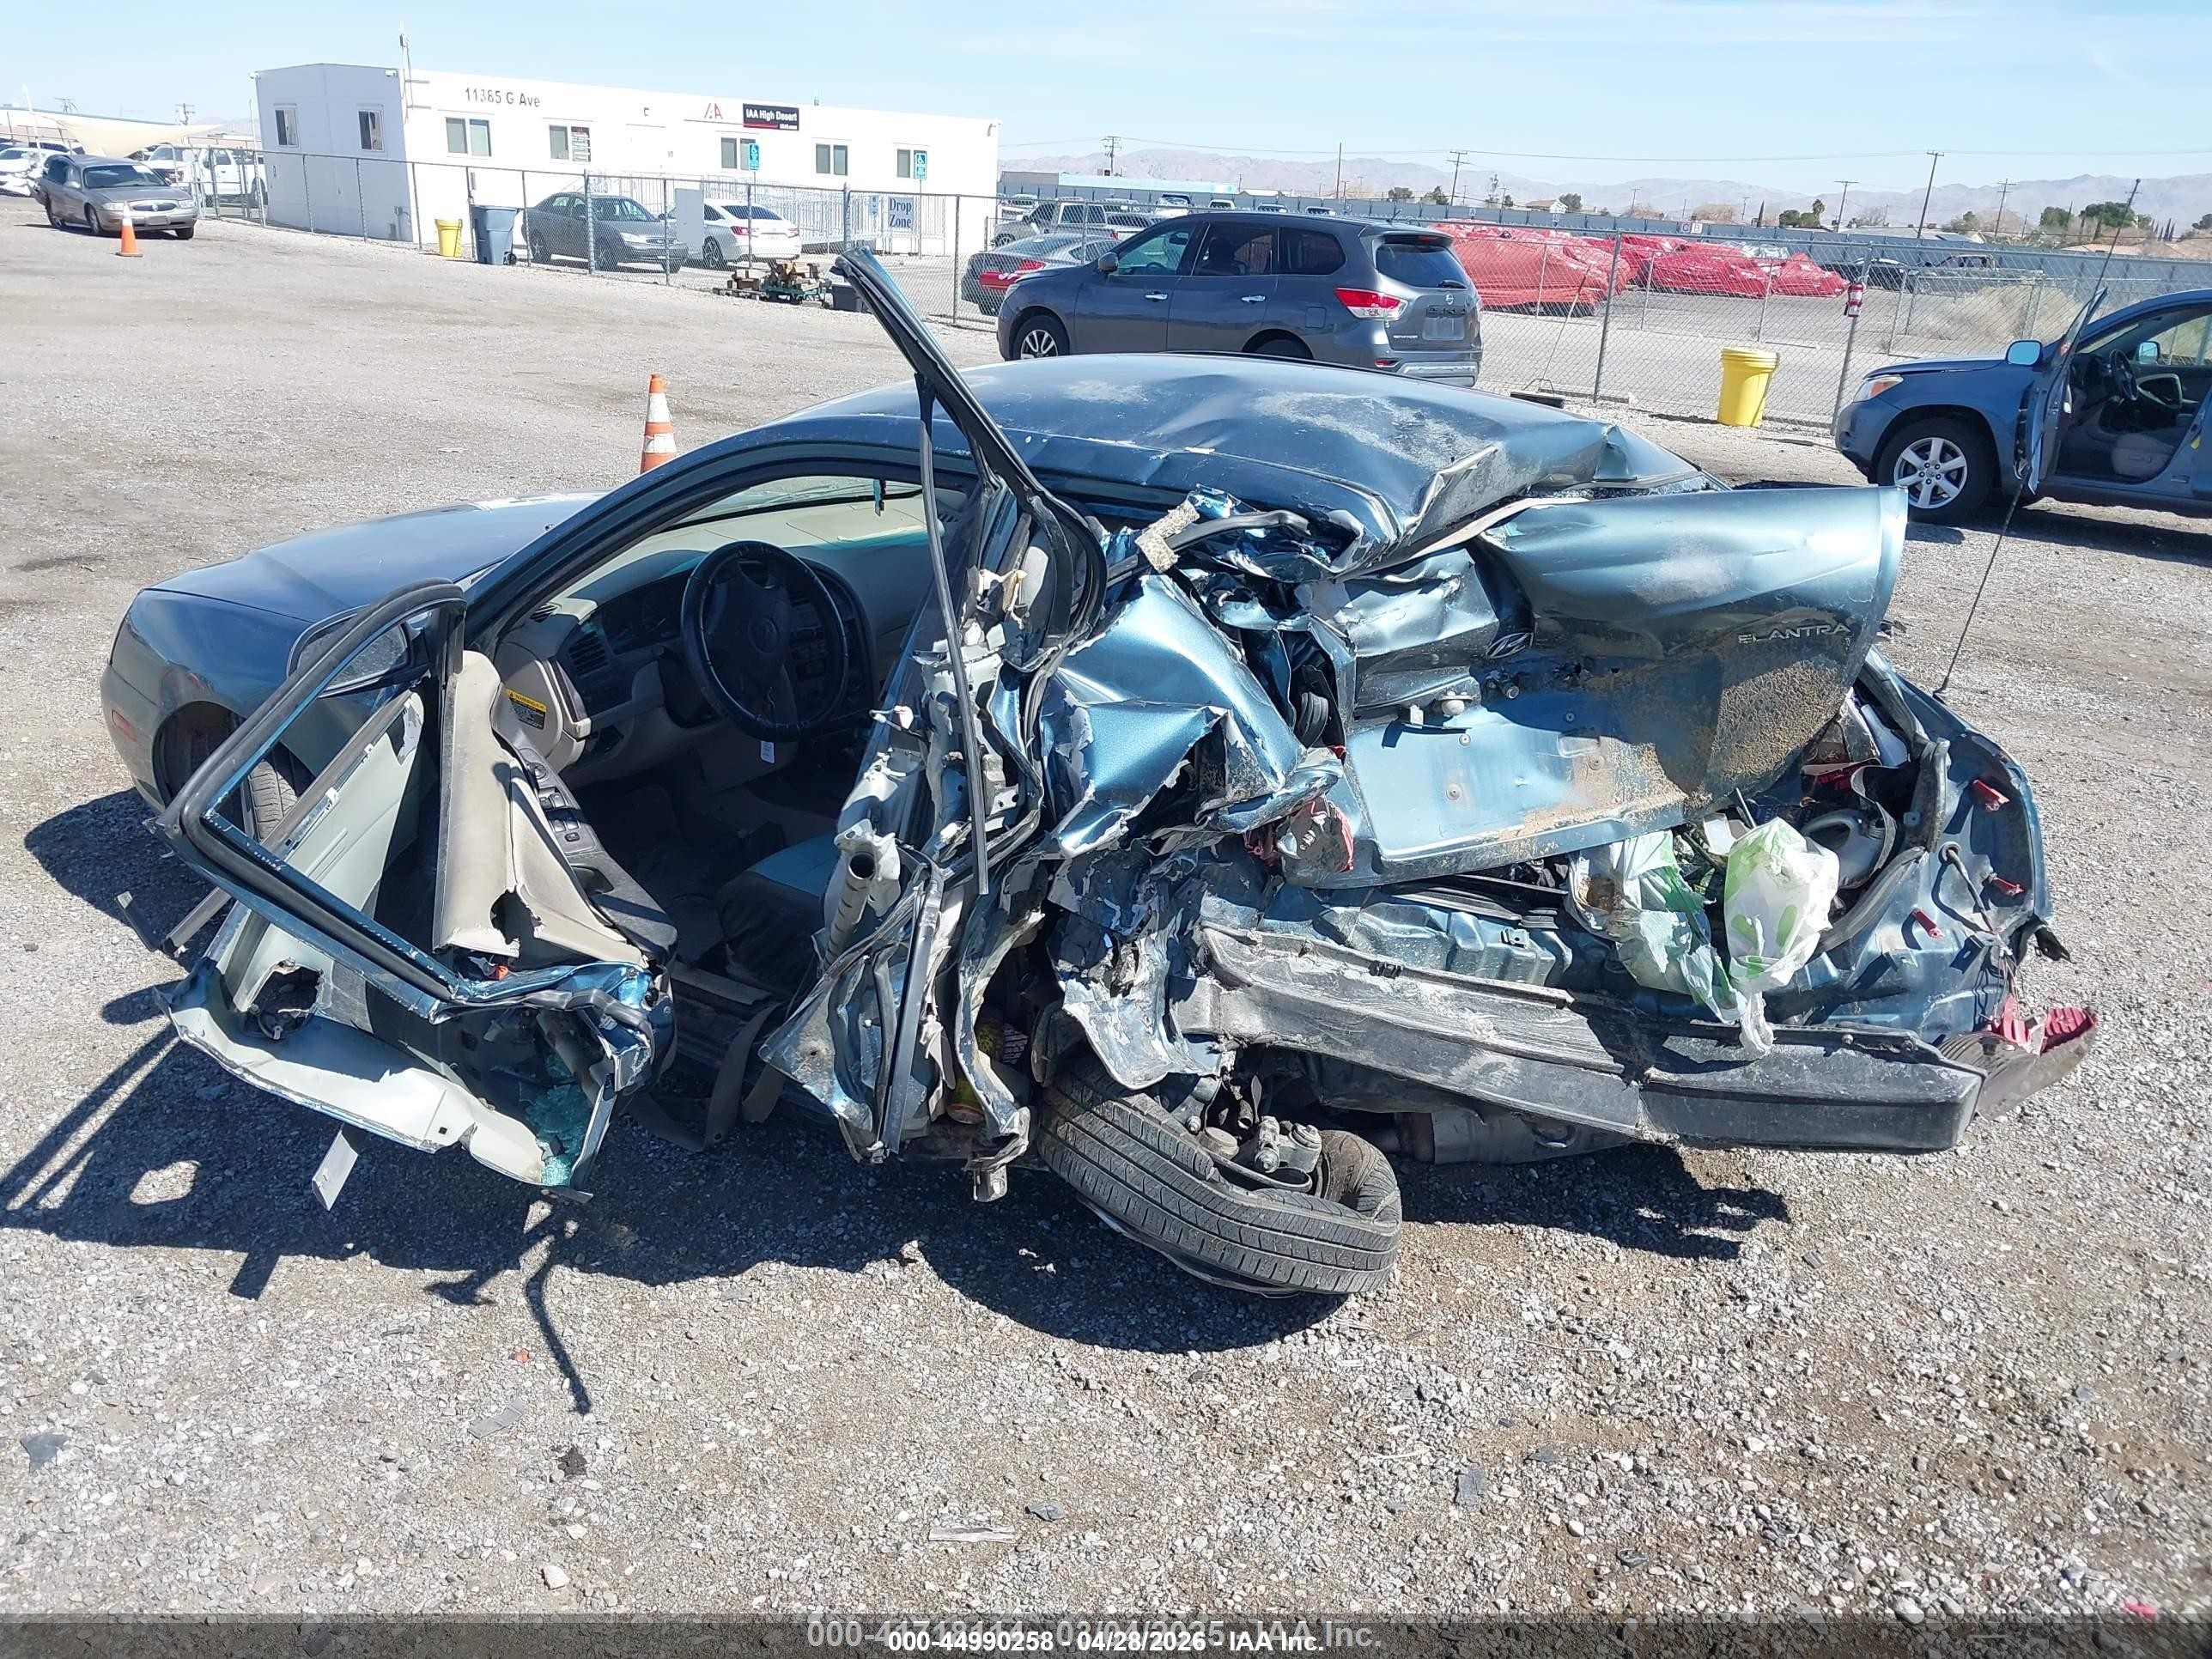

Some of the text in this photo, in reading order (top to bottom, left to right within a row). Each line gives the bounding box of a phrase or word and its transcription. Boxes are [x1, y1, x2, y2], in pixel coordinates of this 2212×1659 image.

[506, 91, 514, 105] G
[519, 92, 541, 107] Ave
[745, 107, 798, 122] IAA High Desert
[890, 198, 912, 215] Drop
[889, 215, 912, 228] Zone
[1737, 623, 1851, 645] ELANTRA
